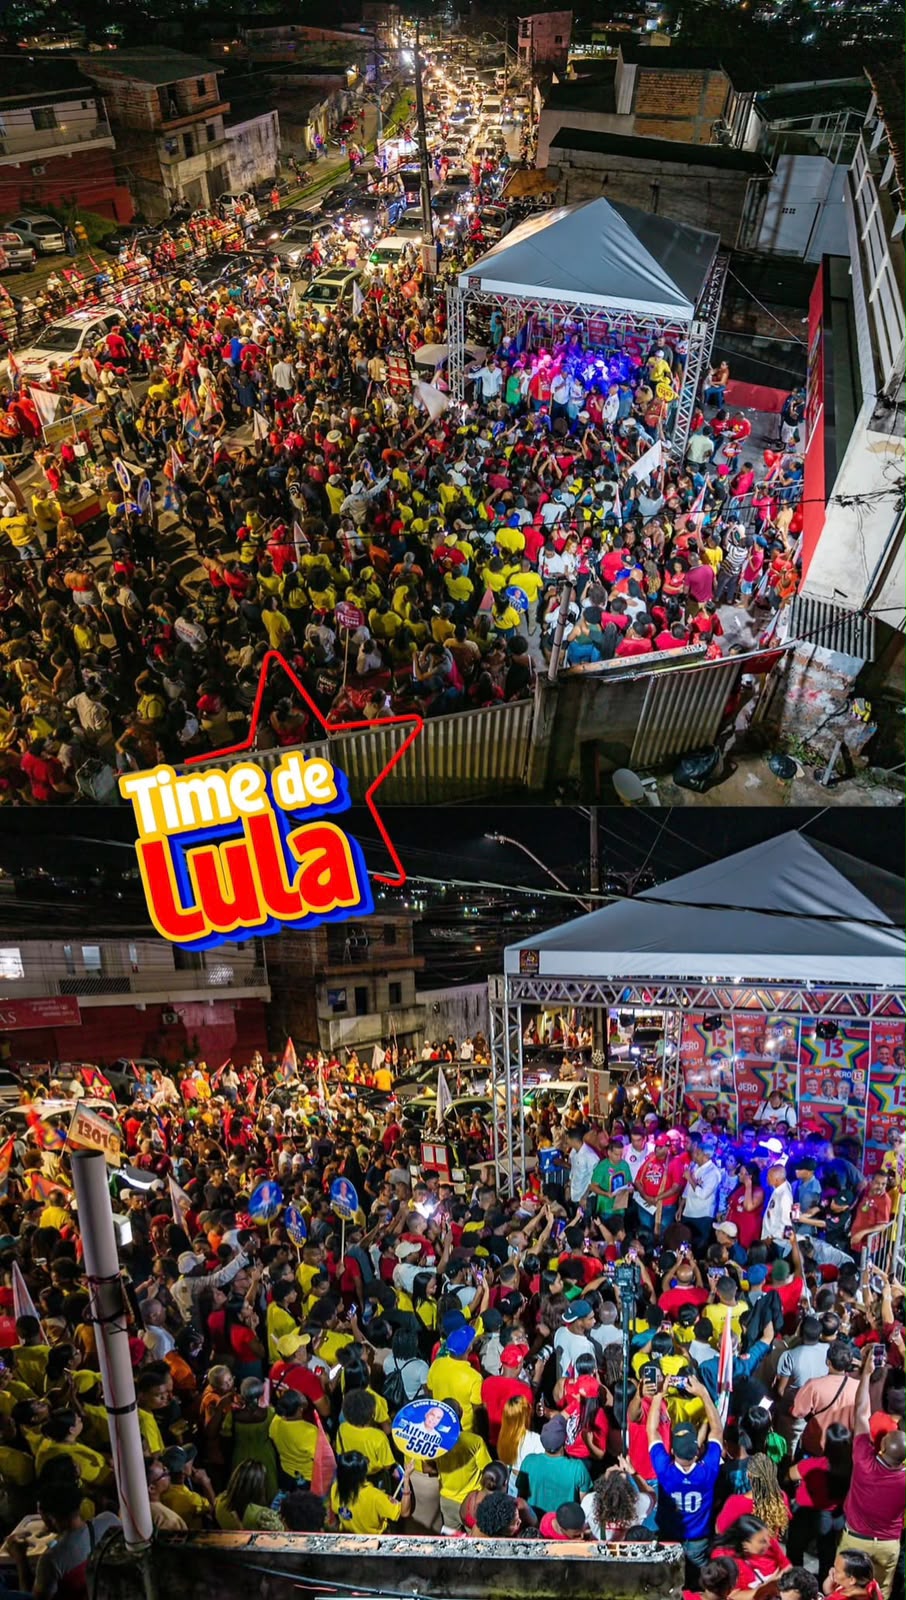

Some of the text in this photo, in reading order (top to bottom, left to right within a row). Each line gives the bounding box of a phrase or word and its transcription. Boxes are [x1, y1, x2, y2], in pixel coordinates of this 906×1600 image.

[712, 1030, 727, 1048] 13
[824, 1038, 844, 1058] 13
[771, 1072, 788, 1092] 13
[833, 1069, 852, 1080] JERO
[853, 1070, 864, 1083] 13
[738, 1083, 758, 1093] JERO
[840, 1116, 858, 1136] 13
[402, 1424, 442, 1445] Alfredo
[406, 1436, 439, 1458] 5505
[671, 1491, 703, 1513] 10
